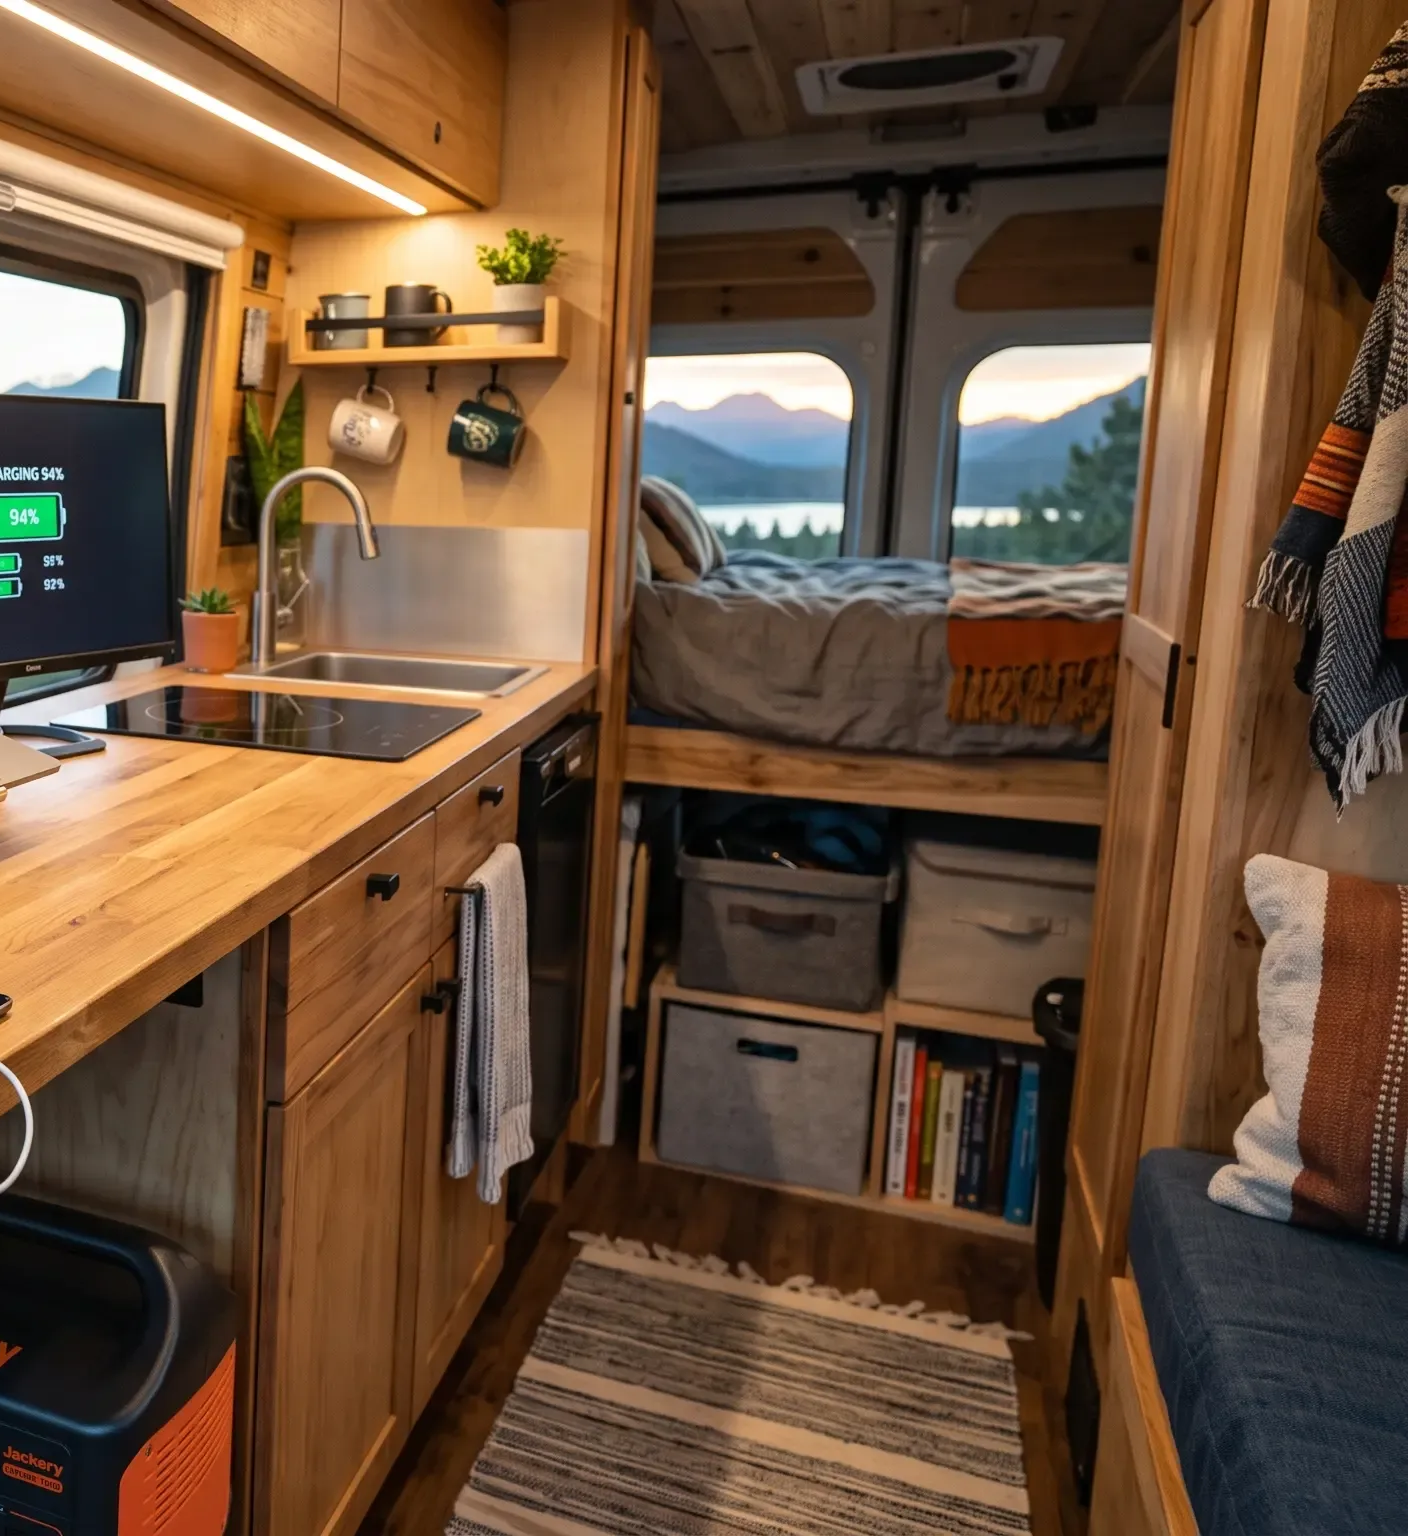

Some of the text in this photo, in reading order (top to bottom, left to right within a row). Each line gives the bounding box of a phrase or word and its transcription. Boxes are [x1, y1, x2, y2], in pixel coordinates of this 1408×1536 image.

[9, 508, 40, 526] 94%
[44, 578, 65, 591] 92%
[3, 1446, 63, 1478] Jackery
